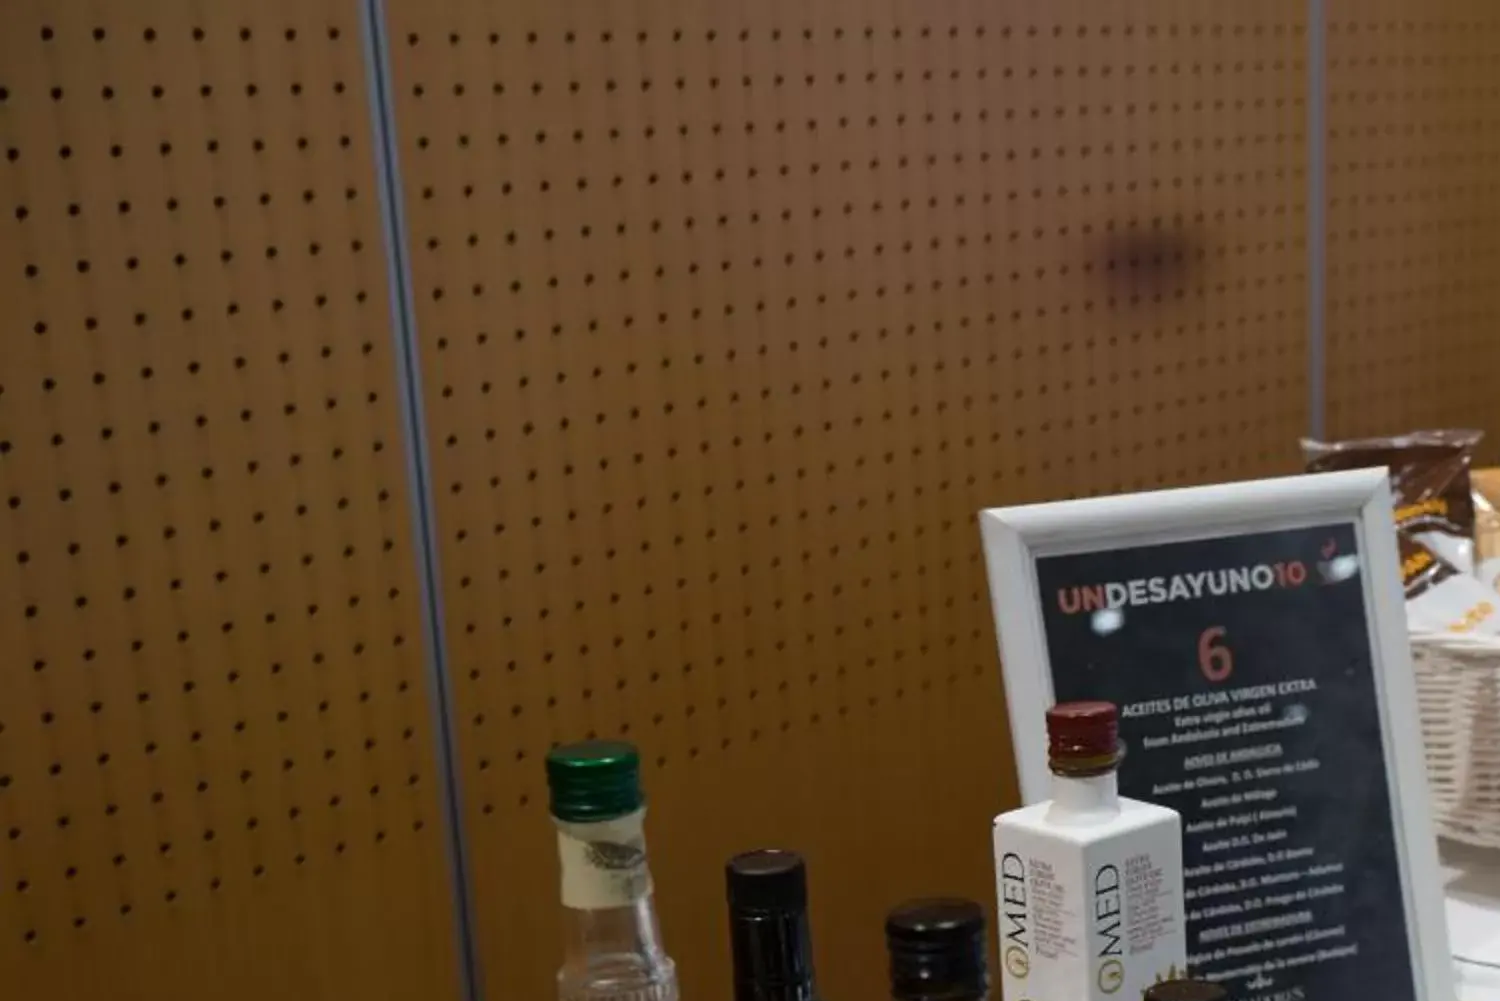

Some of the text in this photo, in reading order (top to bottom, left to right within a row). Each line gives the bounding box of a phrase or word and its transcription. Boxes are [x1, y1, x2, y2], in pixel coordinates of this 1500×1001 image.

[1057, 561, 1307, 614] UNDESAYUNO10
[1198, 625, 1234, 682] 6
[1121, 678, 1317, 718] ACEITES DE OLIVA VIRGEN EXTRA
